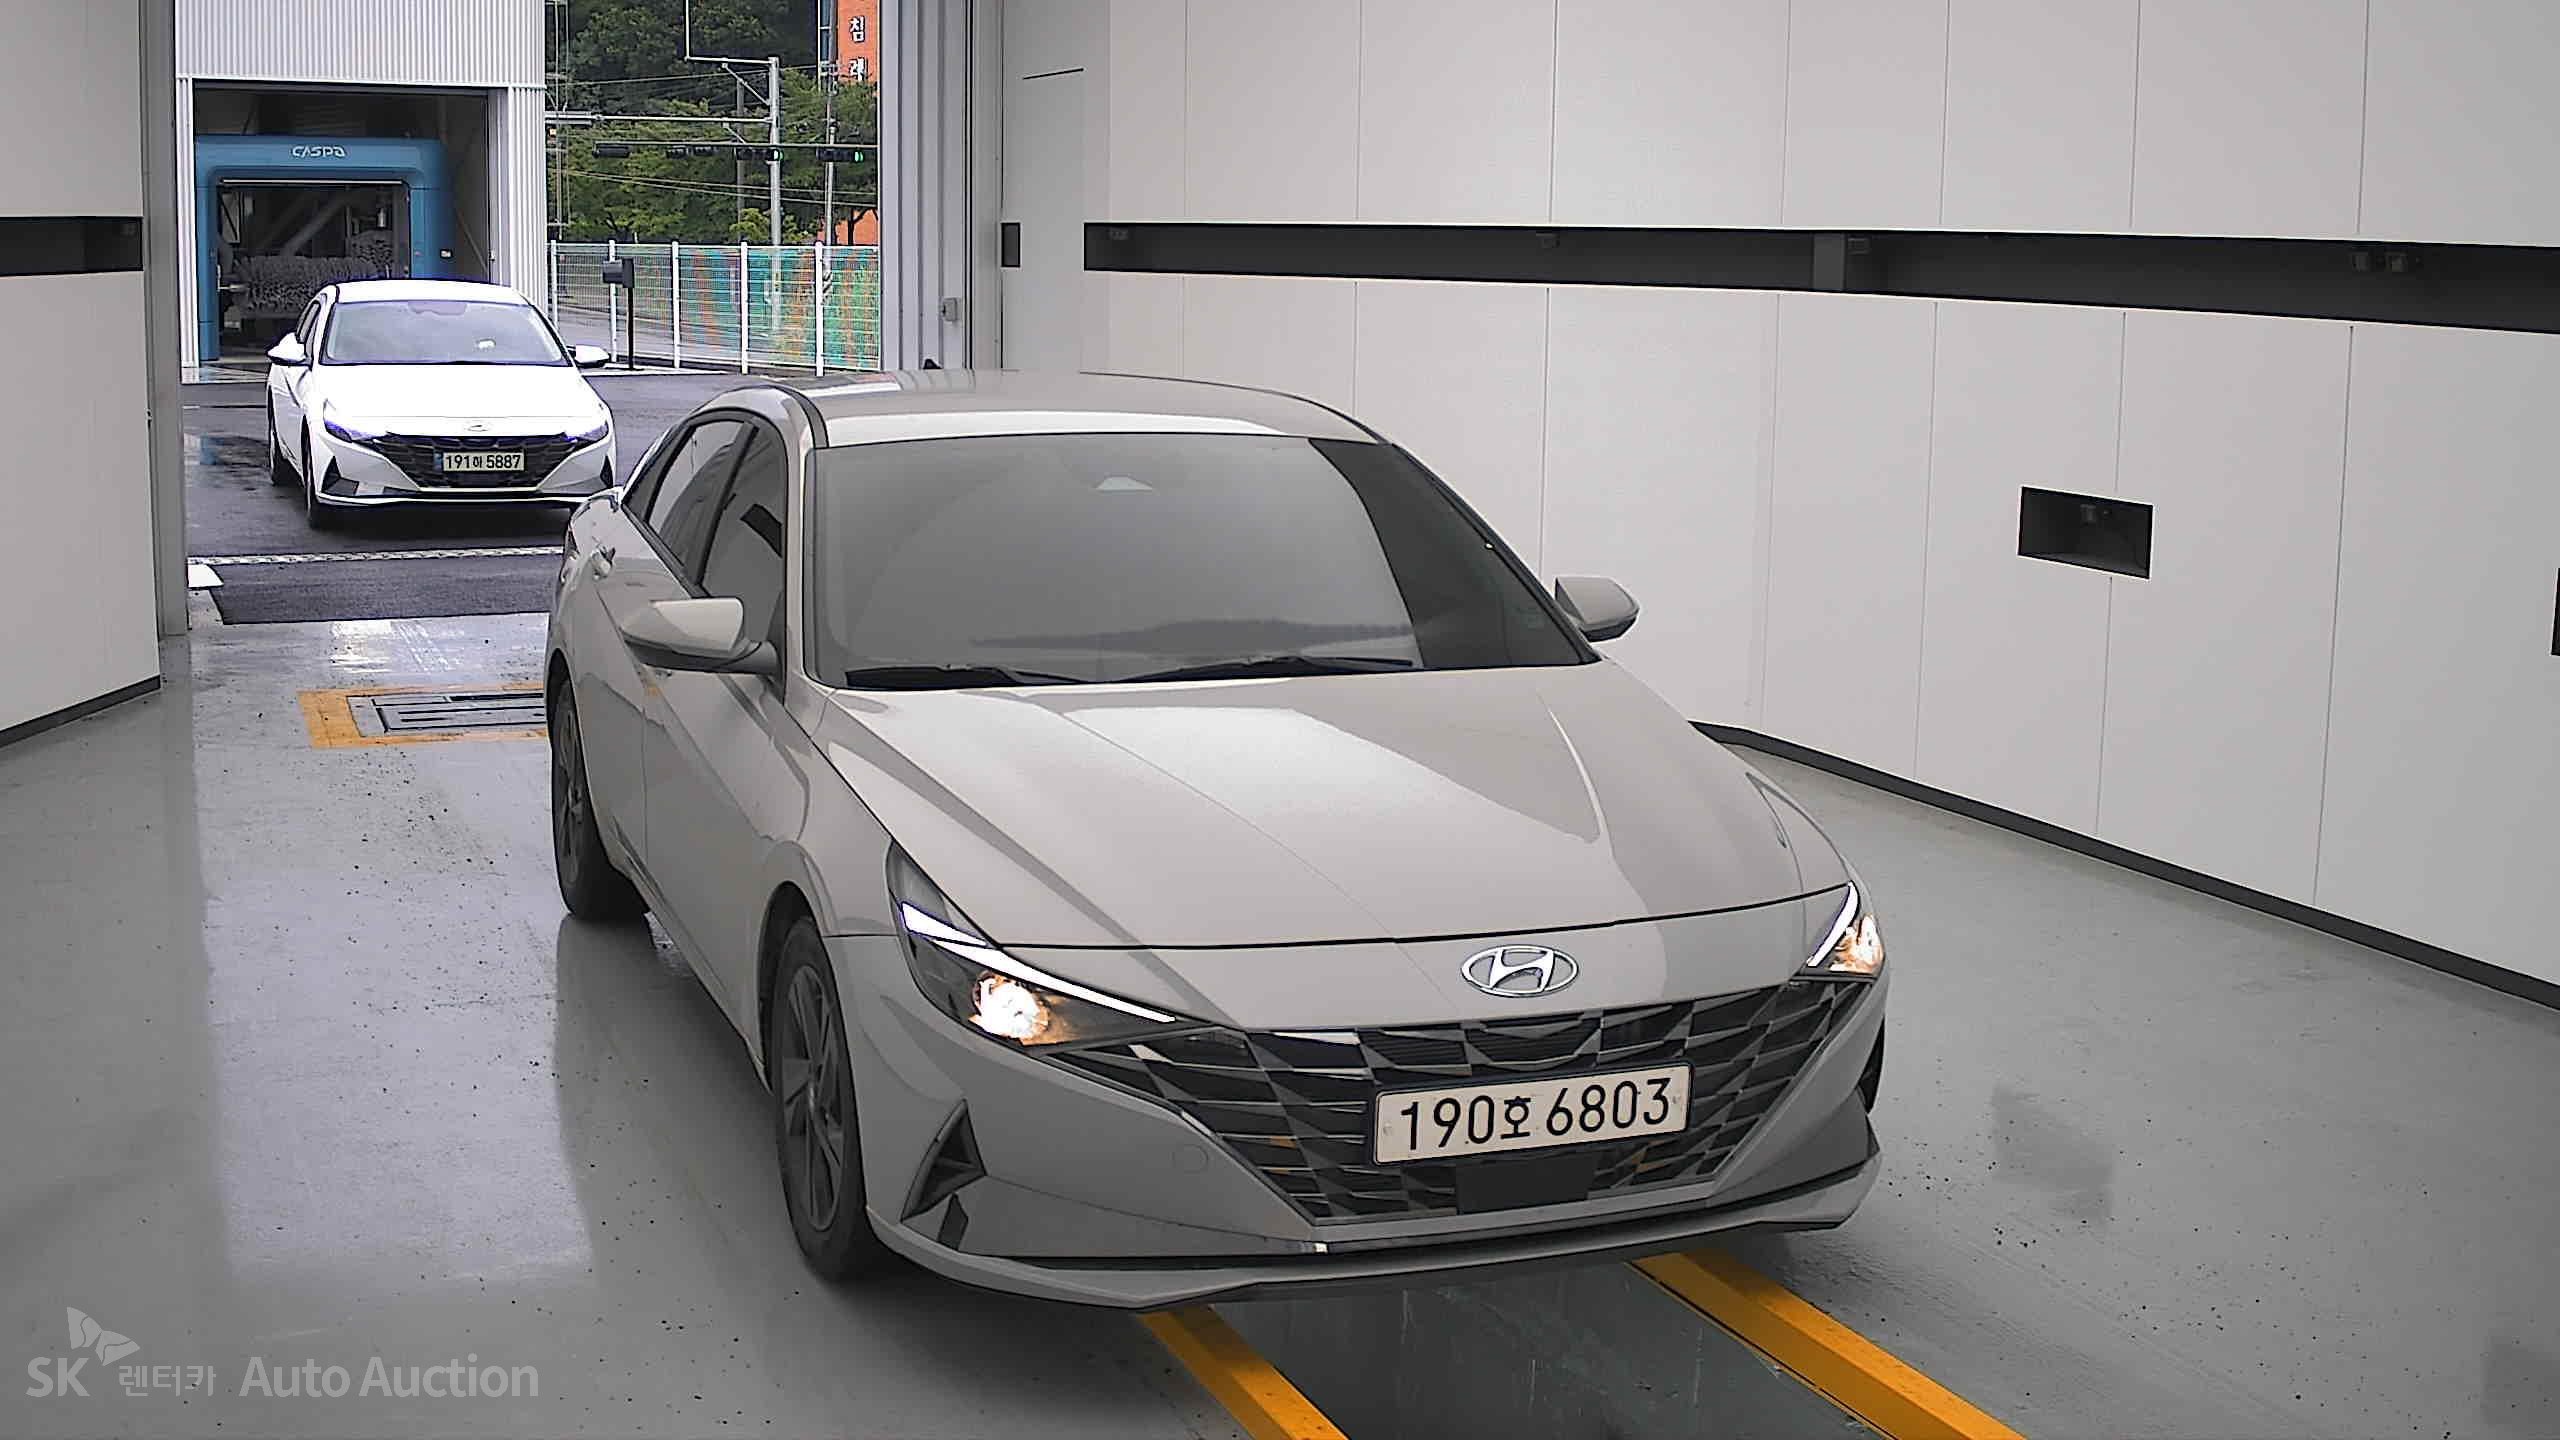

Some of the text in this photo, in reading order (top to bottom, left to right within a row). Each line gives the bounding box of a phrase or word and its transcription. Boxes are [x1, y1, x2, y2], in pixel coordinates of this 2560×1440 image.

[486, 454, 521, 469] 5887
[1400, 1077, 1671, 1151] 190호 6803
